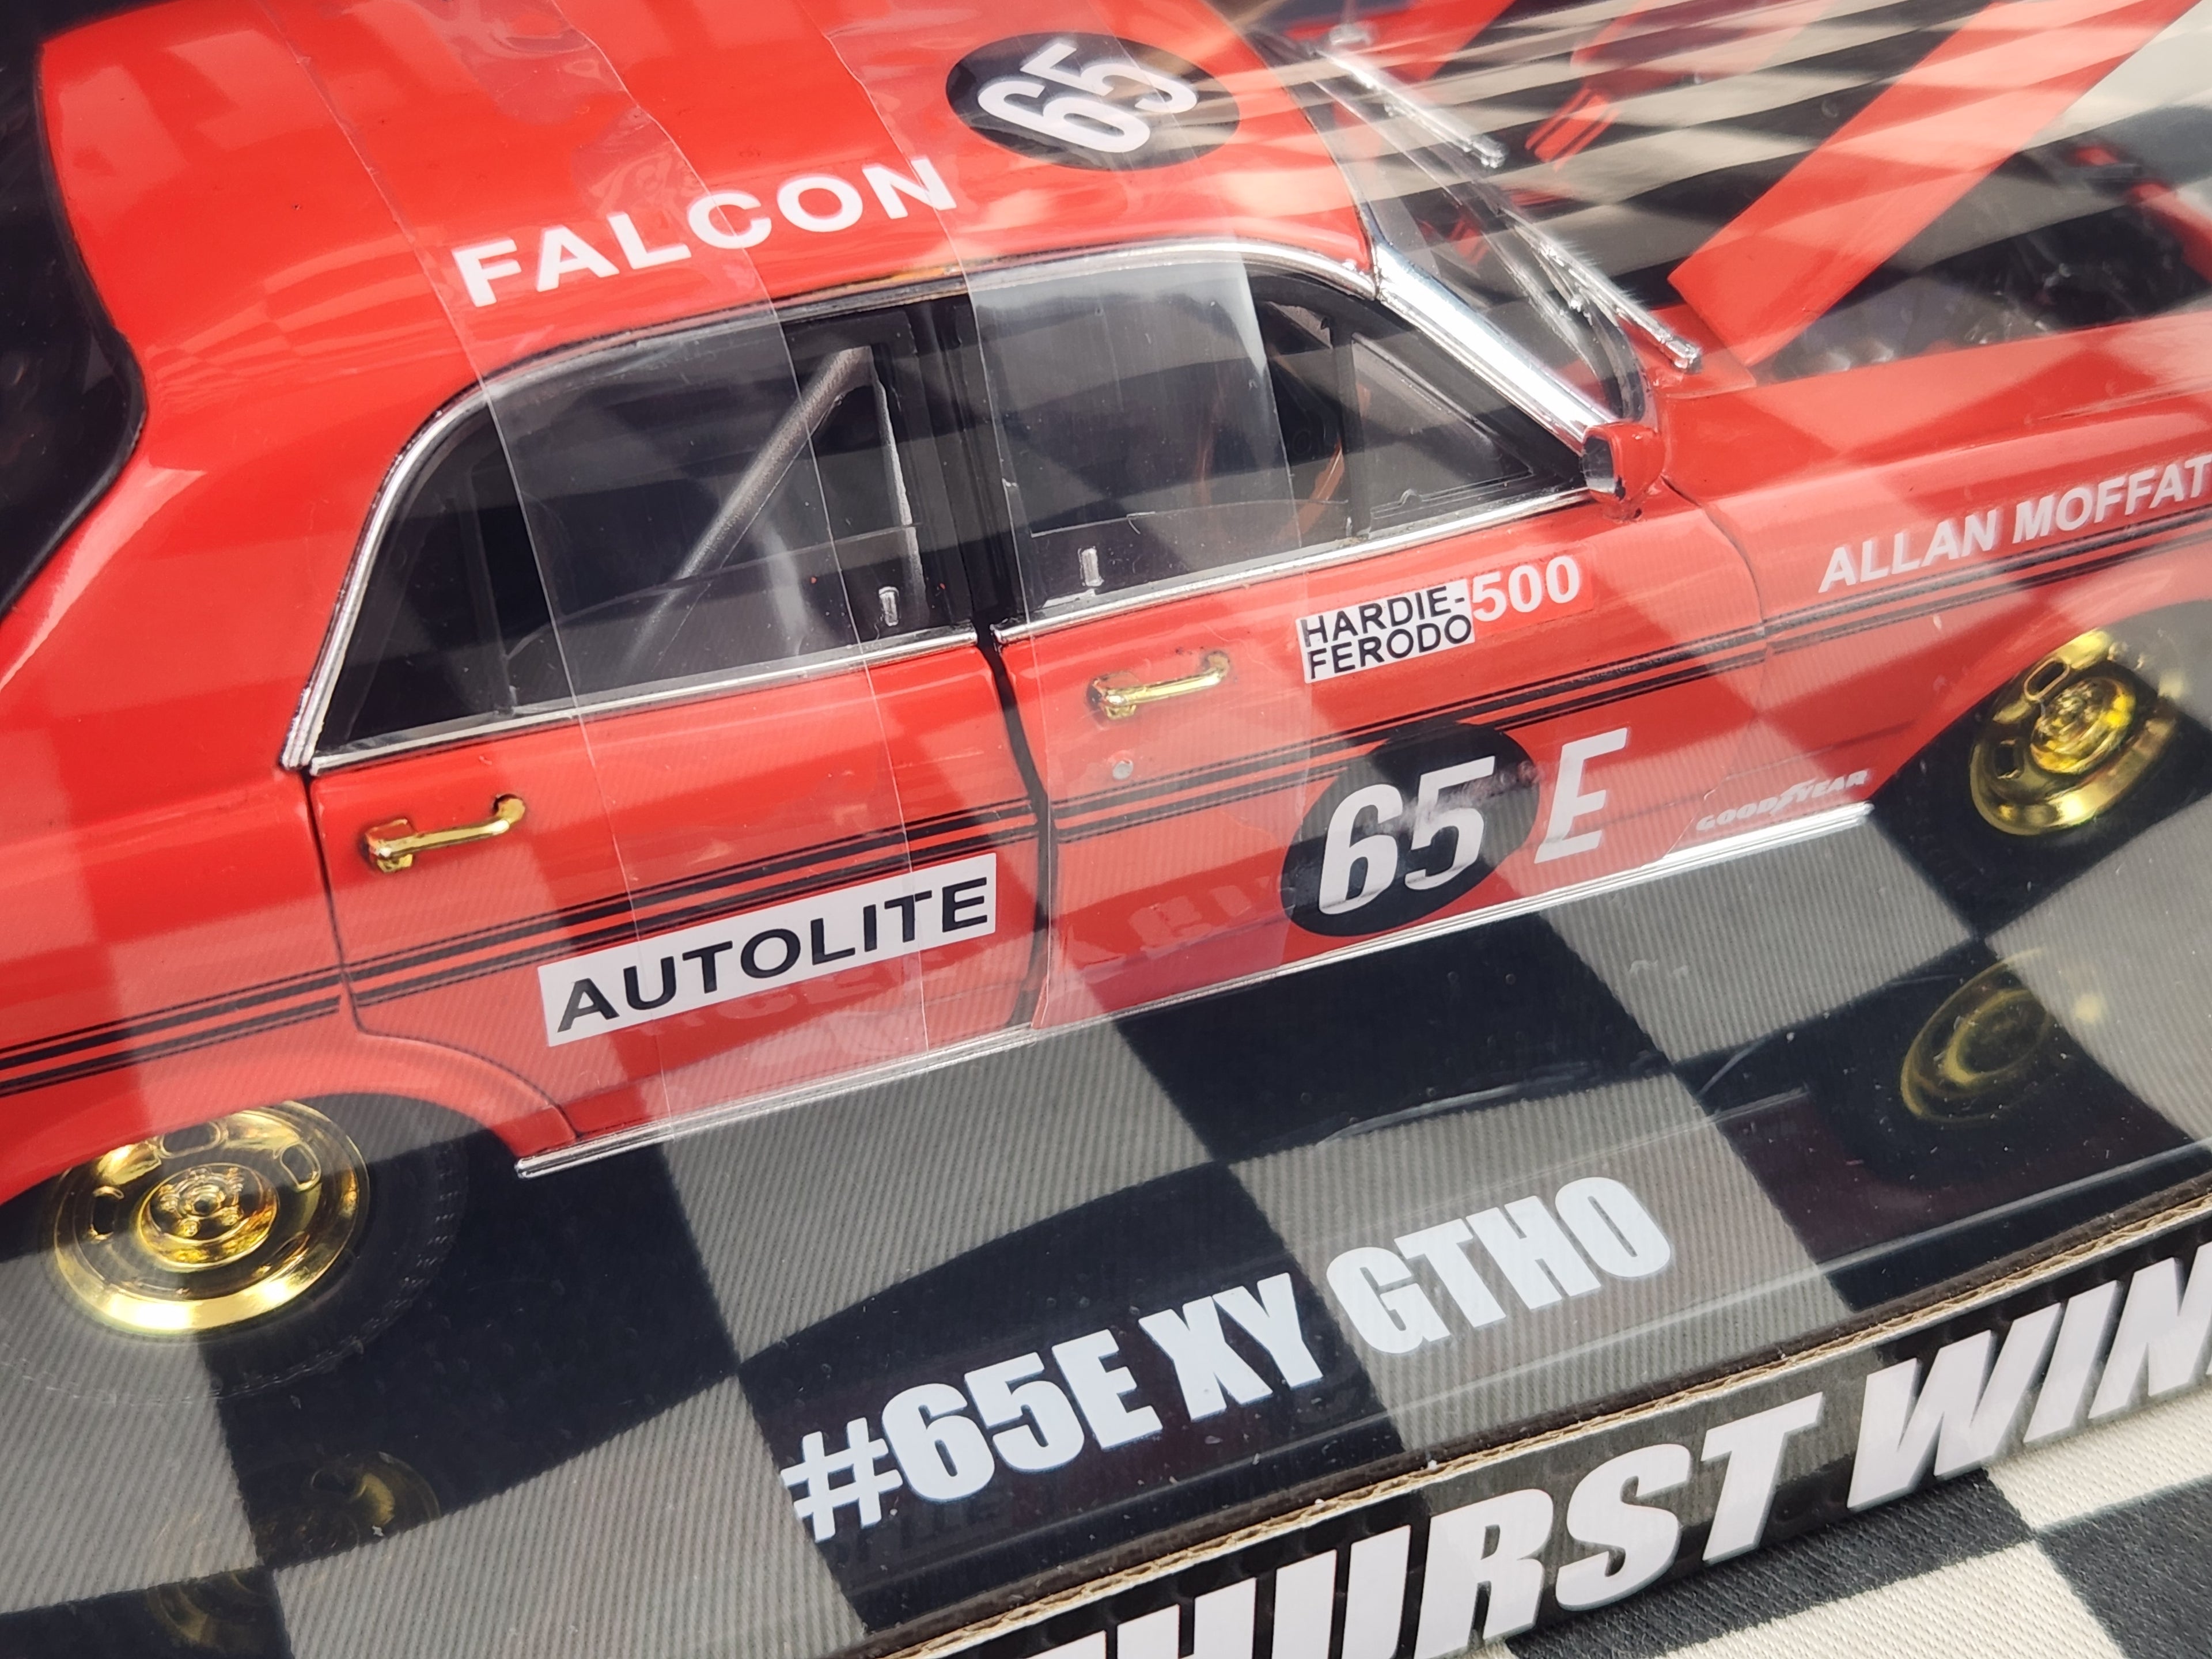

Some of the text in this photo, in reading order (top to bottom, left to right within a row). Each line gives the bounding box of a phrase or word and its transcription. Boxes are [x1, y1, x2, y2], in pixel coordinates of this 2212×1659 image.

[977, 41, 1198, 153] 65
[451, 156, 957, 308] FALCON
[1472, 555, 1581, 622] 500
[1819, 454, 2212, 593] ALLAN MOFFAT
[1300, 585, 1465, 647] HARDIE-
[1307, 614, 1472, 679] FERODO
[1319, 727, 1628, 915] 65 E
[1695, 769, 1869, 831] GOODYEAR
[556, 877, 988, 1033] AUTOLITE
[781, 1176, 1673, 1543] #65E XY GTHO
[1847, 1241, 2212, 1512] WIN
